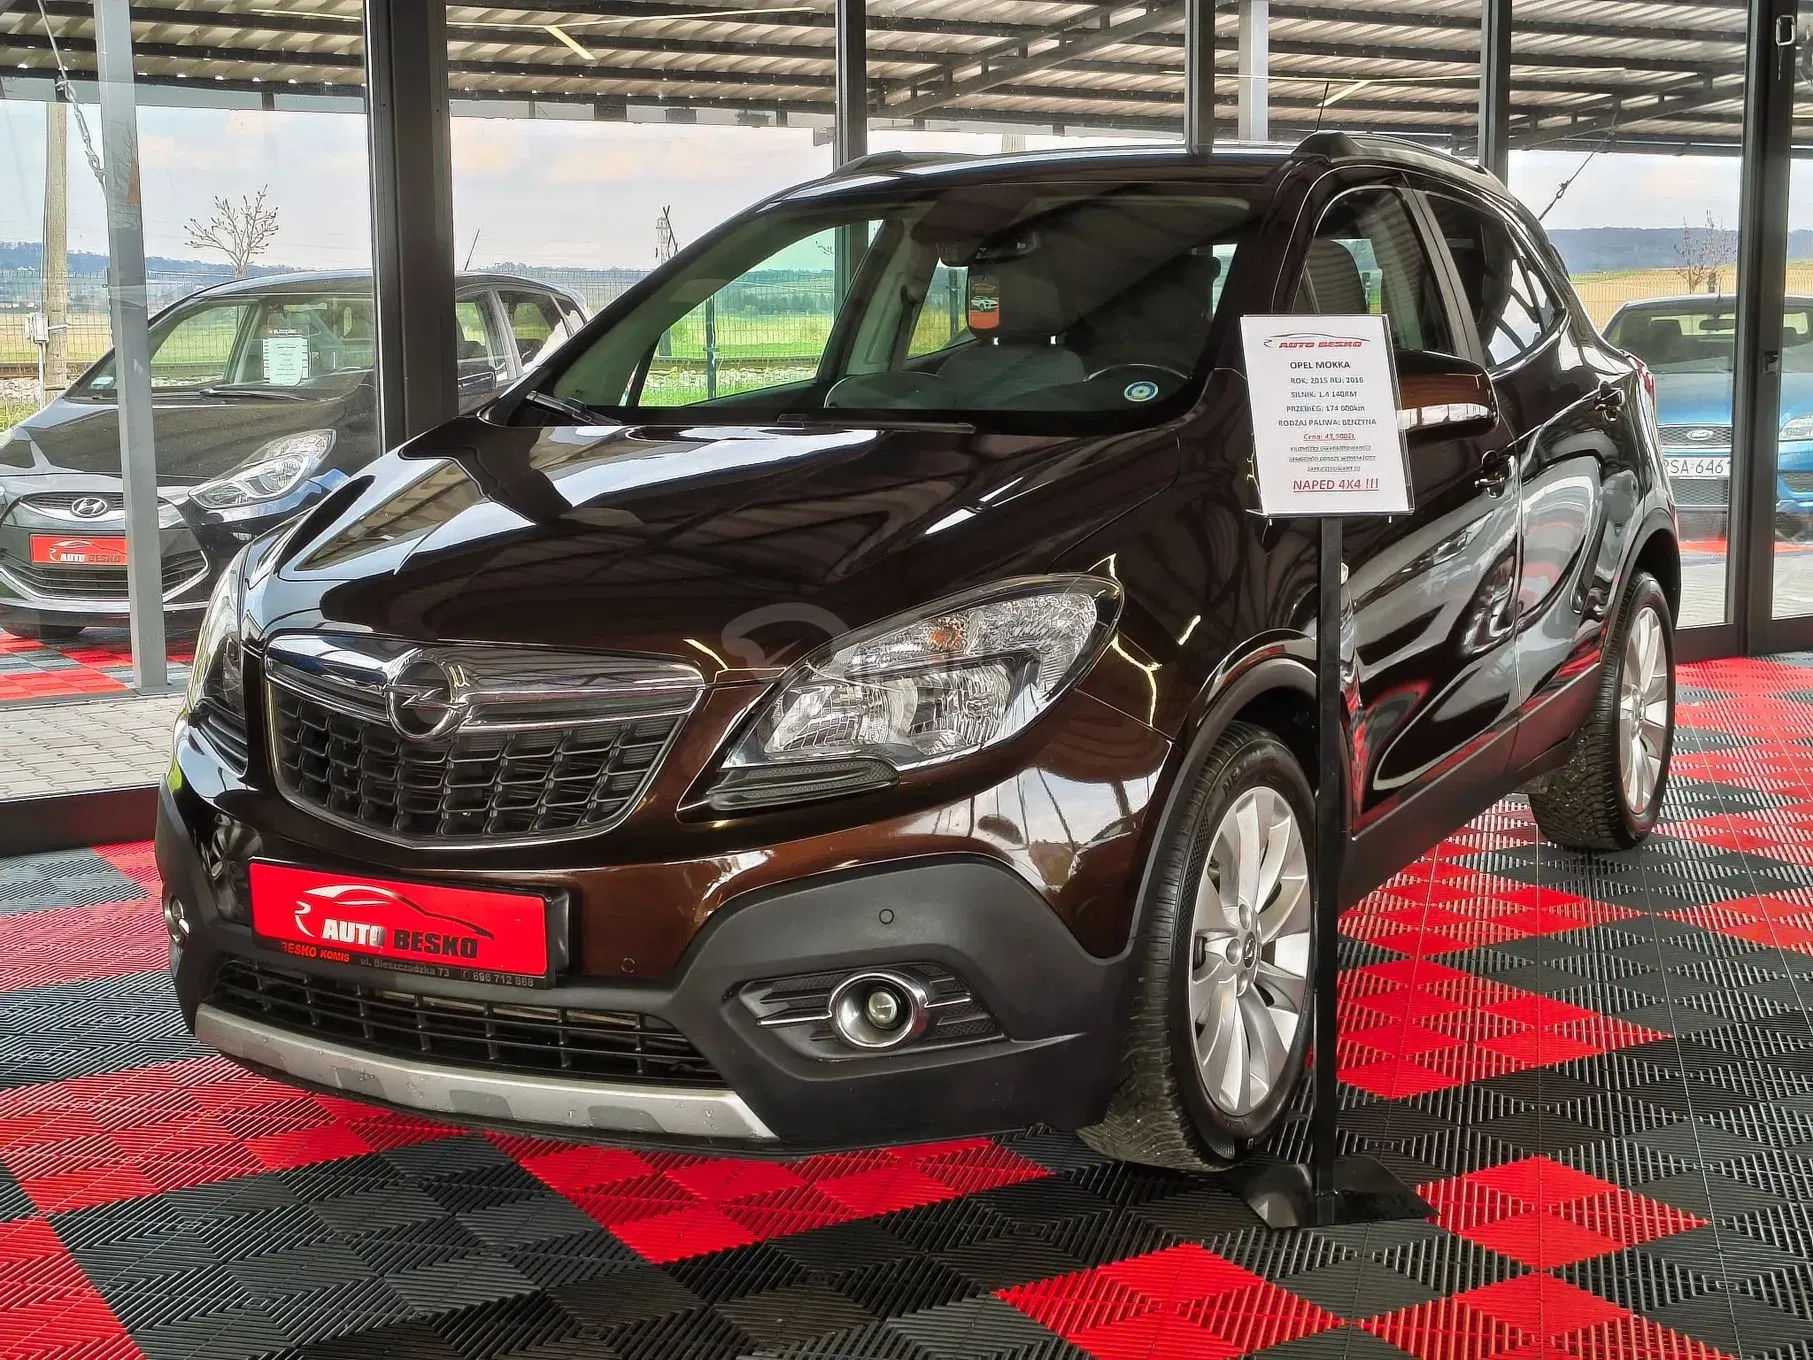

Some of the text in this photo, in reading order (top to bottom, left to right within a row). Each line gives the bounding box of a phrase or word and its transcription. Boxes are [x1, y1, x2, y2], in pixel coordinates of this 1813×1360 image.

[1290, 361, 1351, 369] OPEL MOKKA
[1695, 459, 1730, 474] 646
[60, 553, 122, 563] AUTO BESKO
[321, 918, 478, 960] AUTO BESKO
[320, 949, 351, 962] KOMIS
[437, 966, 450, 977] 73
[494, 974, 512, 985] 712
